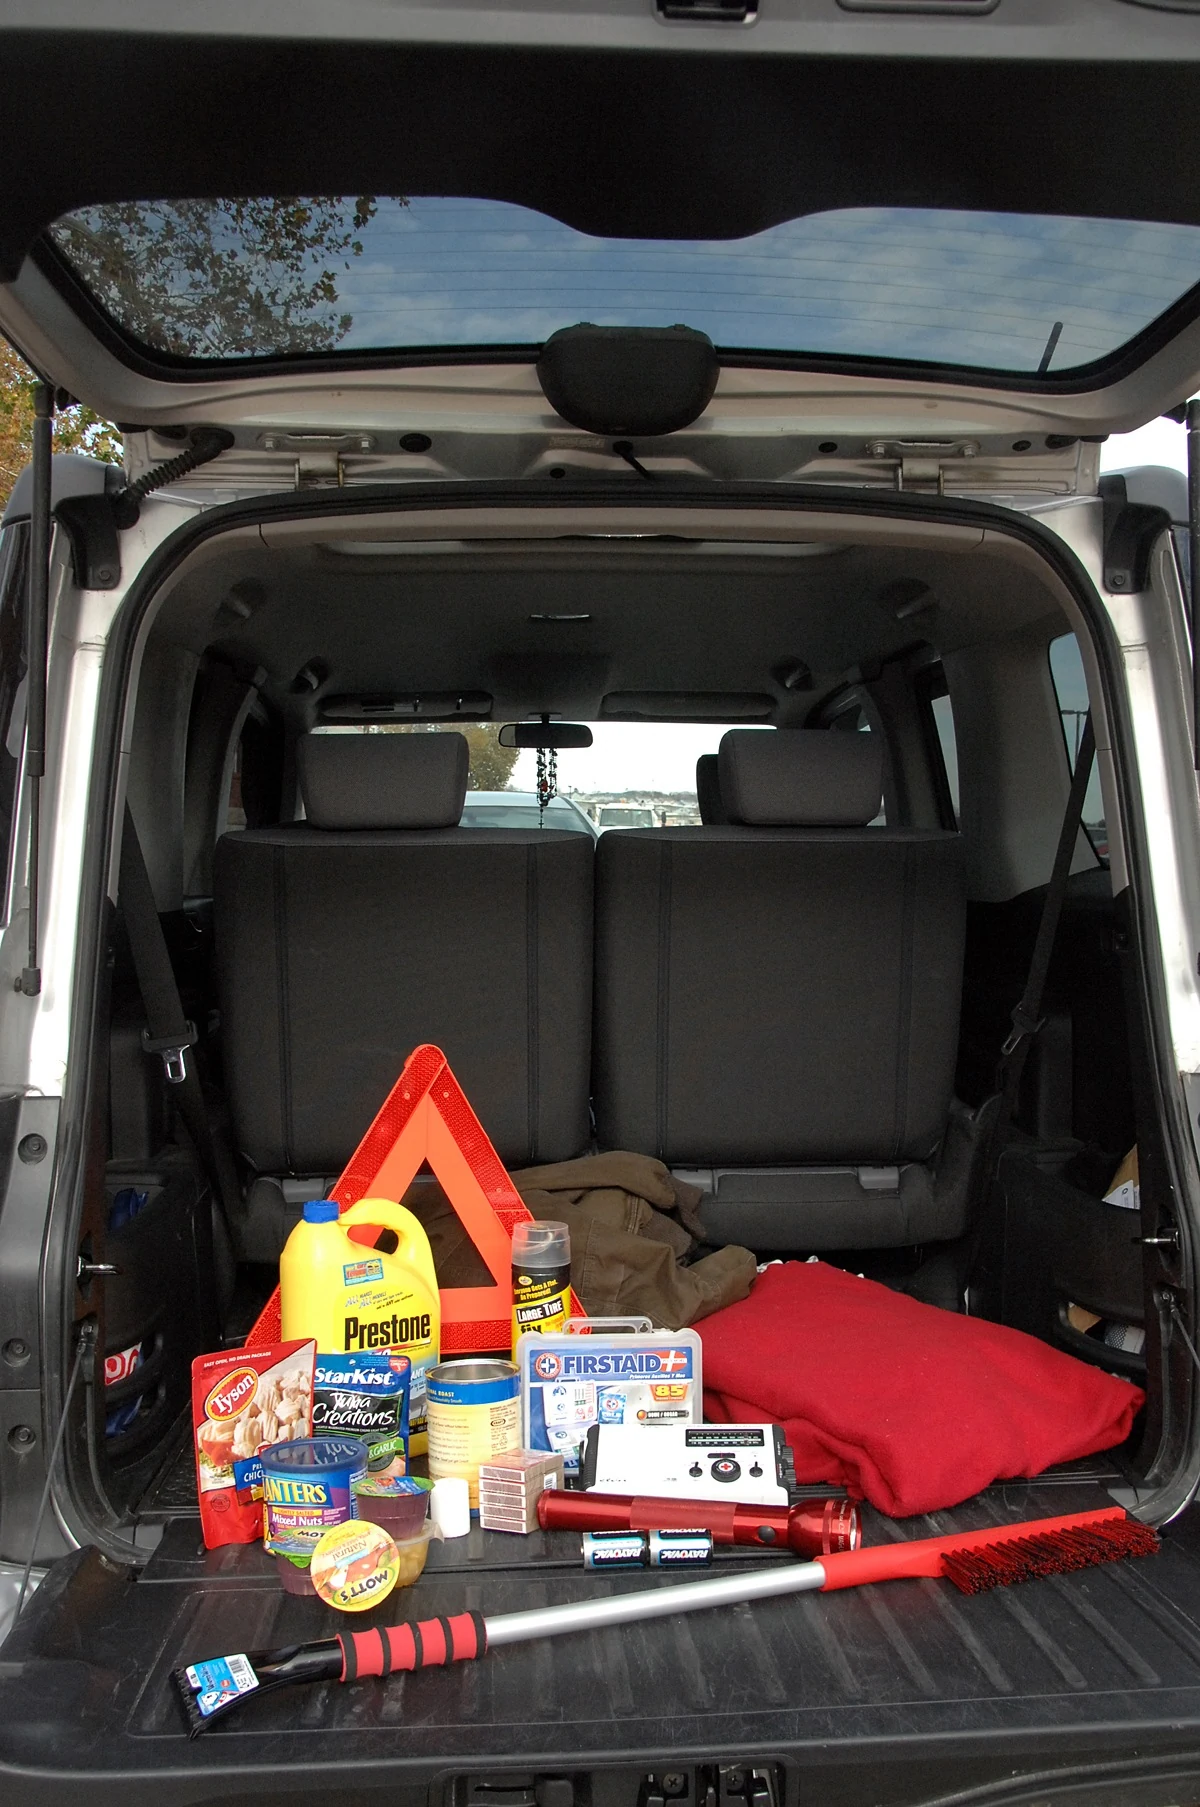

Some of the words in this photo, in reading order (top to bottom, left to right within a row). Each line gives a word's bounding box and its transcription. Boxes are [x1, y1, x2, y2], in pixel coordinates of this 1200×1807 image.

[517, 1308, 543, 1322] LARGE
[543, 1300, 563, 1316] TIRE
[344, 1313, 431, 1351] Prestone
[313, 1368, 394, 1385] StarKist
[210, 1375, 255, 1414] Tyson
[655, 1385, 685, 1397] 85
[329, 1392, 371, 1411] Tuna
[374, 1439, 398, 1455] GARLIC
[264, 1479, 327, 1504] ANTERS
[271, 1513, 297, 1526] Mixed
[298, 1516, 324, 1526] Nuts
[332, 1540, 368, 1562] Natural
[593, 1547, 642, 1559] RAYOVAC
[660, 1549, 709, 1559] RAYOVAC
